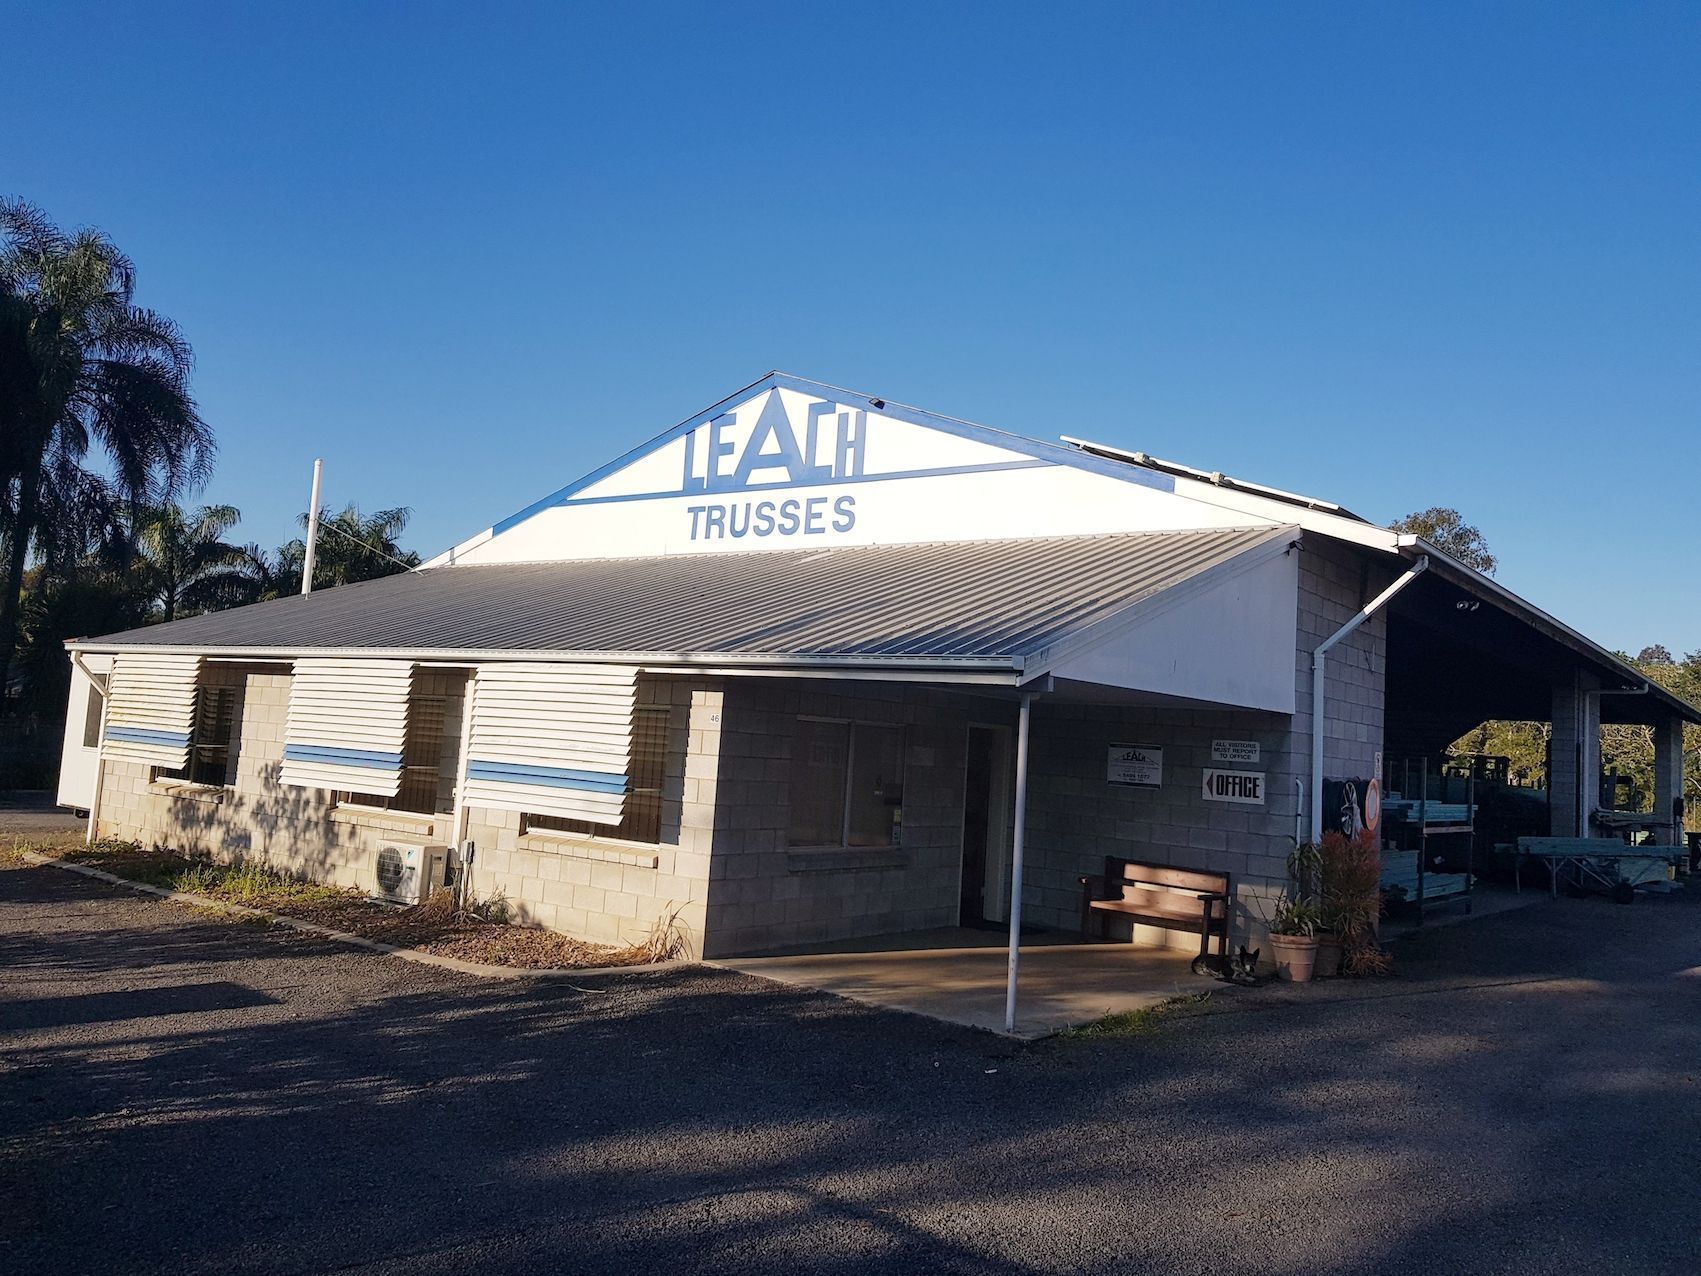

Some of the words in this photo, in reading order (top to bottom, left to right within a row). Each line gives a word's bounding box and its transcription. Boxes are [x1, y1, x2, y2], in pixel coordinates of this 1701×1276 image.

[683, 386, 867, 490] LEACH
[687, 495, 856, 541] TRUSSES
[711, 714, 720, 722] 46
[1122, 750, 1146, 762] LEACH
[1217, 774, 1260, 798] OFFICE
